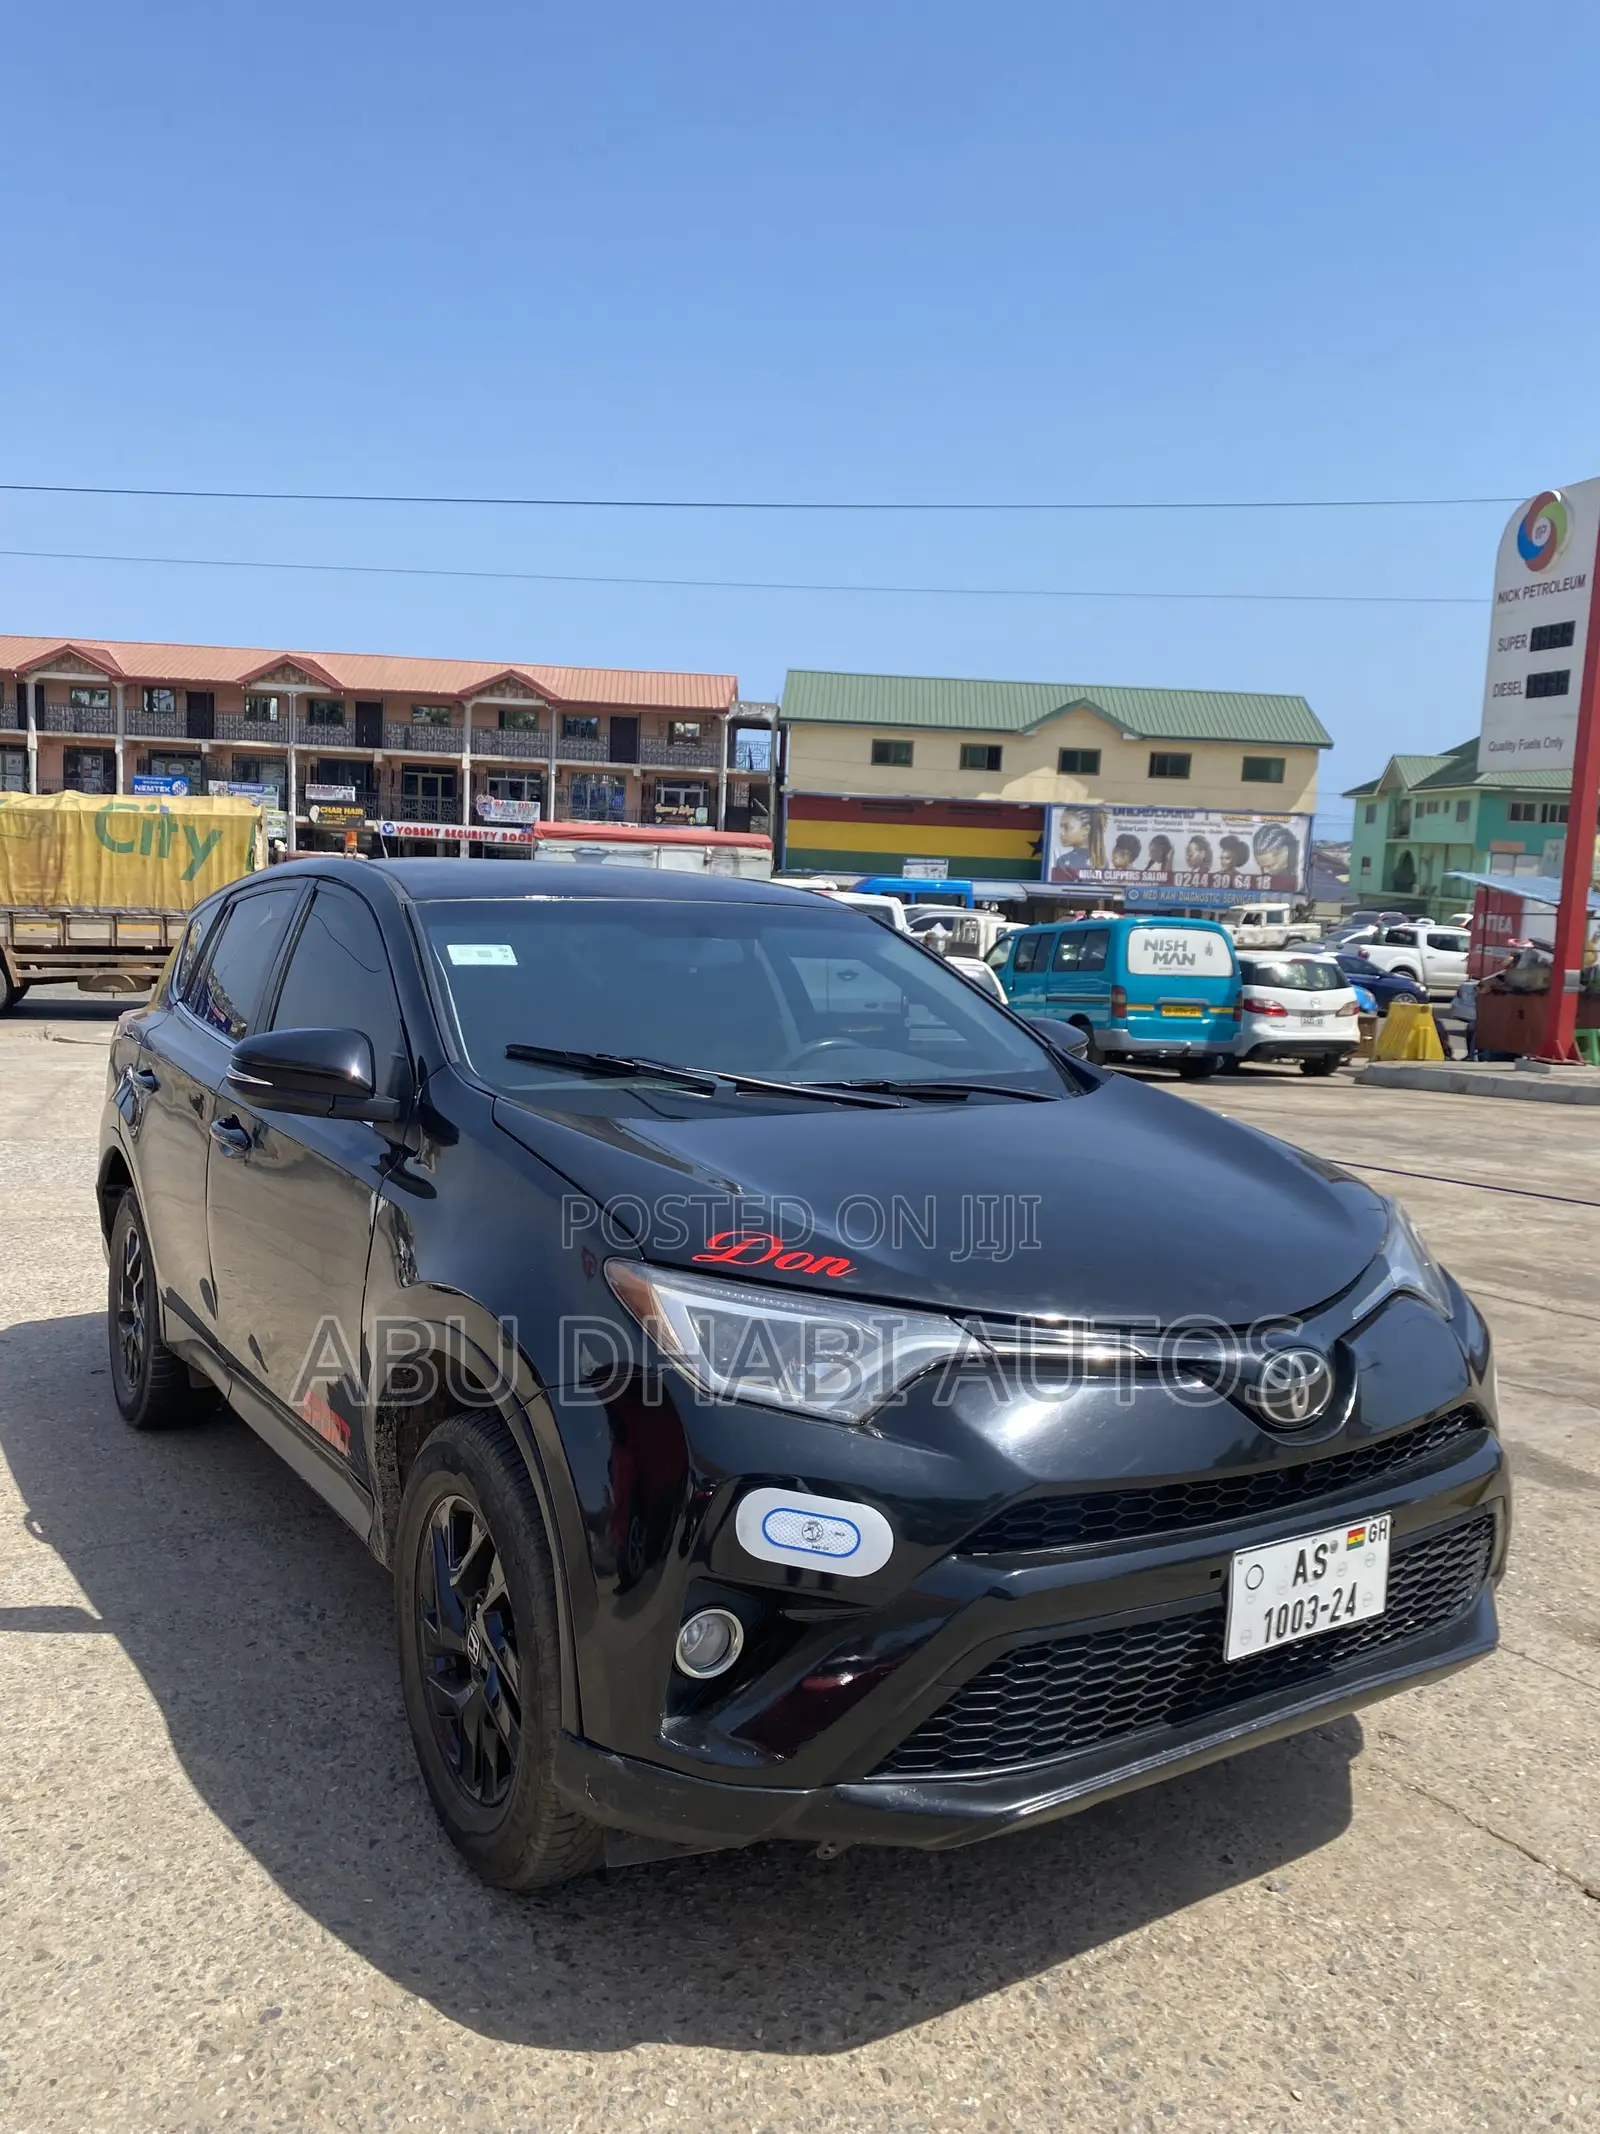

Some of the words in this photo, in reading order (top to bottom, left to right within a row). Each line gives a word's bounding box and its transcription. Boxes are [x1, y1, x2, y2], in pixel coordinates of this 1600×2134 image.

[1497, 587, 1522, 604] NICK
[1523, 574, 1587, 600] PETROLEUM
[1497, 634, 1528, 652] SUPER
[1492, 681, 1523, 698] DIESEL
[1488, 740, 1516, 753] Quality
[1518, 738, 1541, 751] Fuels
[1543, 736, 1564, 752] Only
[134, 784, 171, 793] NEMTEK
[343, 807, 364, 816] HAIR
[94, 802, 223, 881] City
[444, 828, 498, 842] SECURITY
[1104, 870, 1141, 881] CLIPPERS
[1142, 871, 1168, 882] SALON
[1174, 872, 1209, 888] 0244
[1213, 873, 1231, 889] 30
[1234, 874, 1251, 890] 64
[1143, 889, 1158, 900] MED
[1178, 891, 1220, 903] DIAGNOSTIC
[1143, 939, 1188, 952] NISH
[1152, 952, 1196, 966] MAN
[692, 1230, 857, 1277] Don
[1367, 1518, 1388, 1544] GH
[1292, 1543, 1330, 1588] AS
[1264, 1581, 1358, 1644] 1003-24
